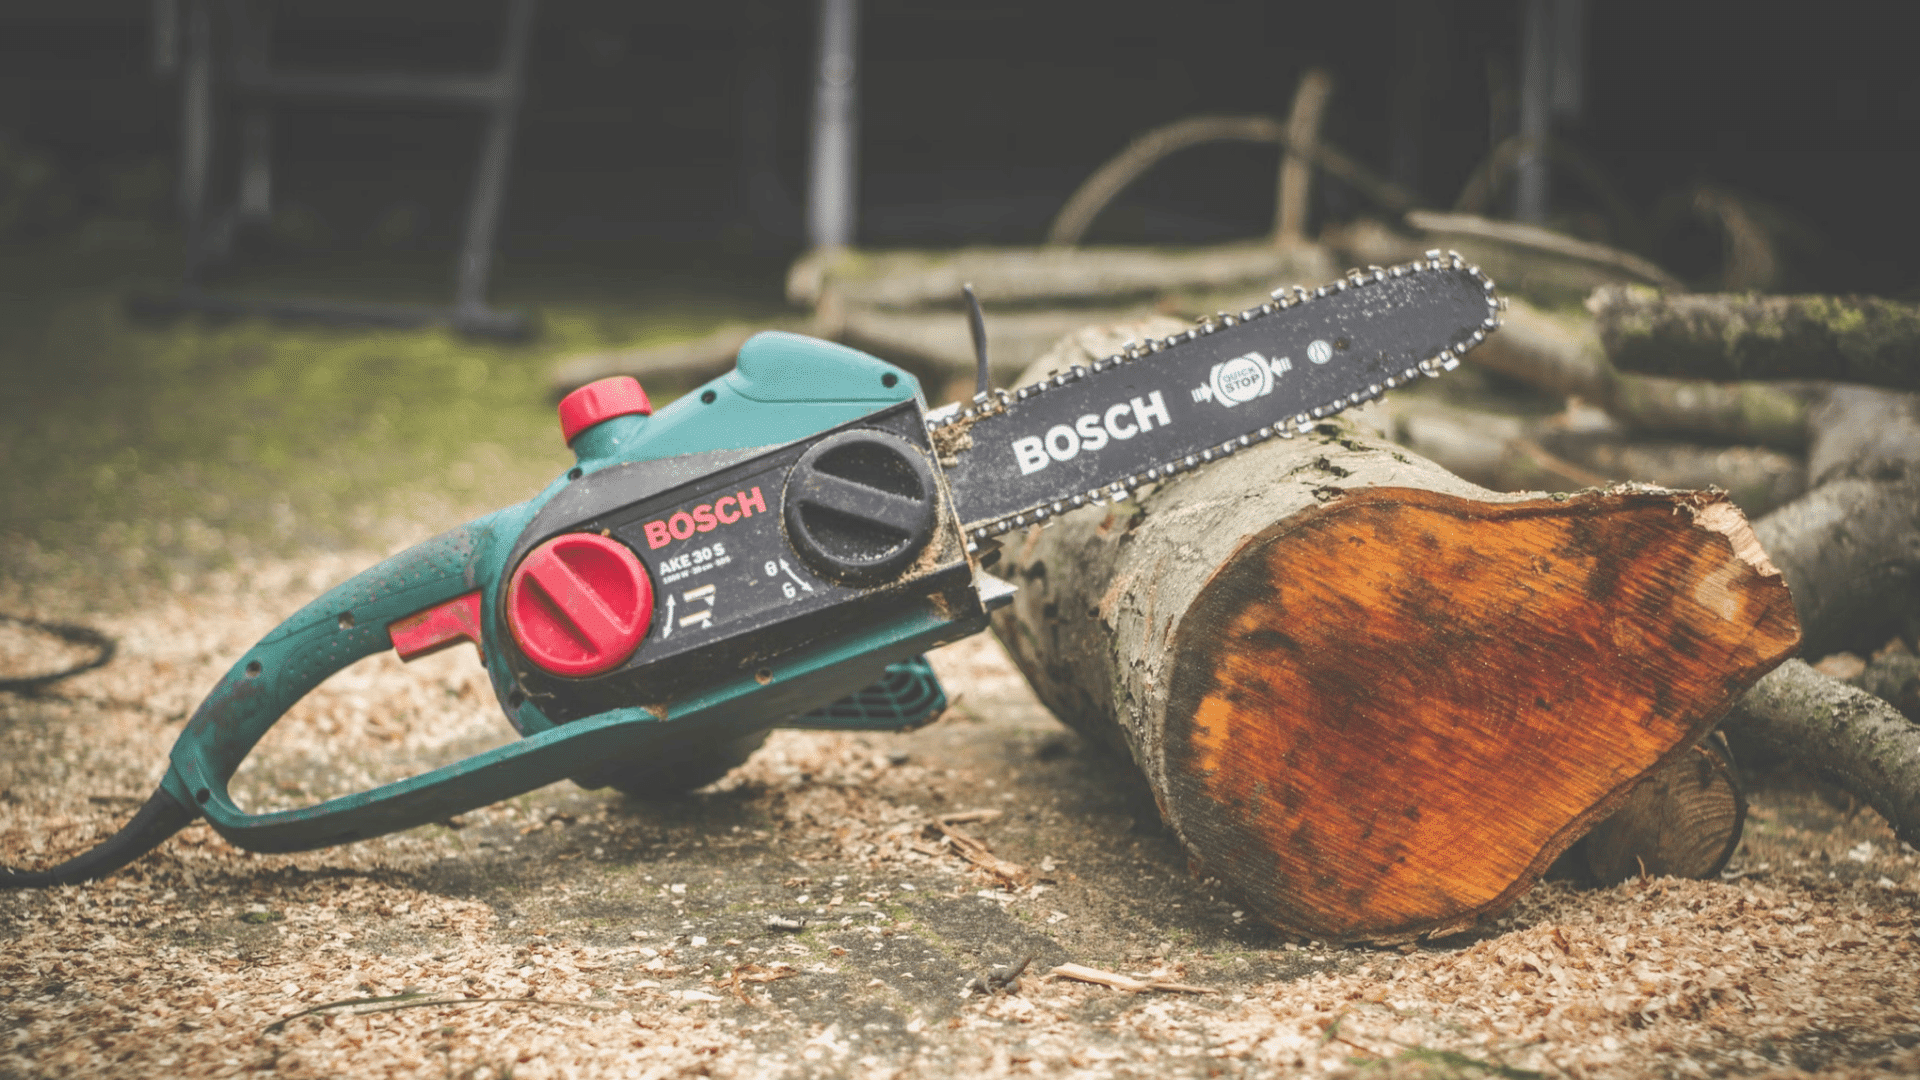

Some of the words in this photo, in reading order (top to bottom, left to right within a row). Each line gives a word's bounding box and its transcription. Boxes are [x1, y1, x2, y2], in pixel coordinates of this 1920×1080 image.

[1223, 367, 1255, 382] QUICK
[1225, 374, 1260, 393] STOP
[1012, 390, 1172, 476] BOSCH
[643, 486, 767, 550] BOSCH
[660, 553, 692, 576] AKE
[691, 547, 712, 564] 30
[712, 542, 725, 557] S
